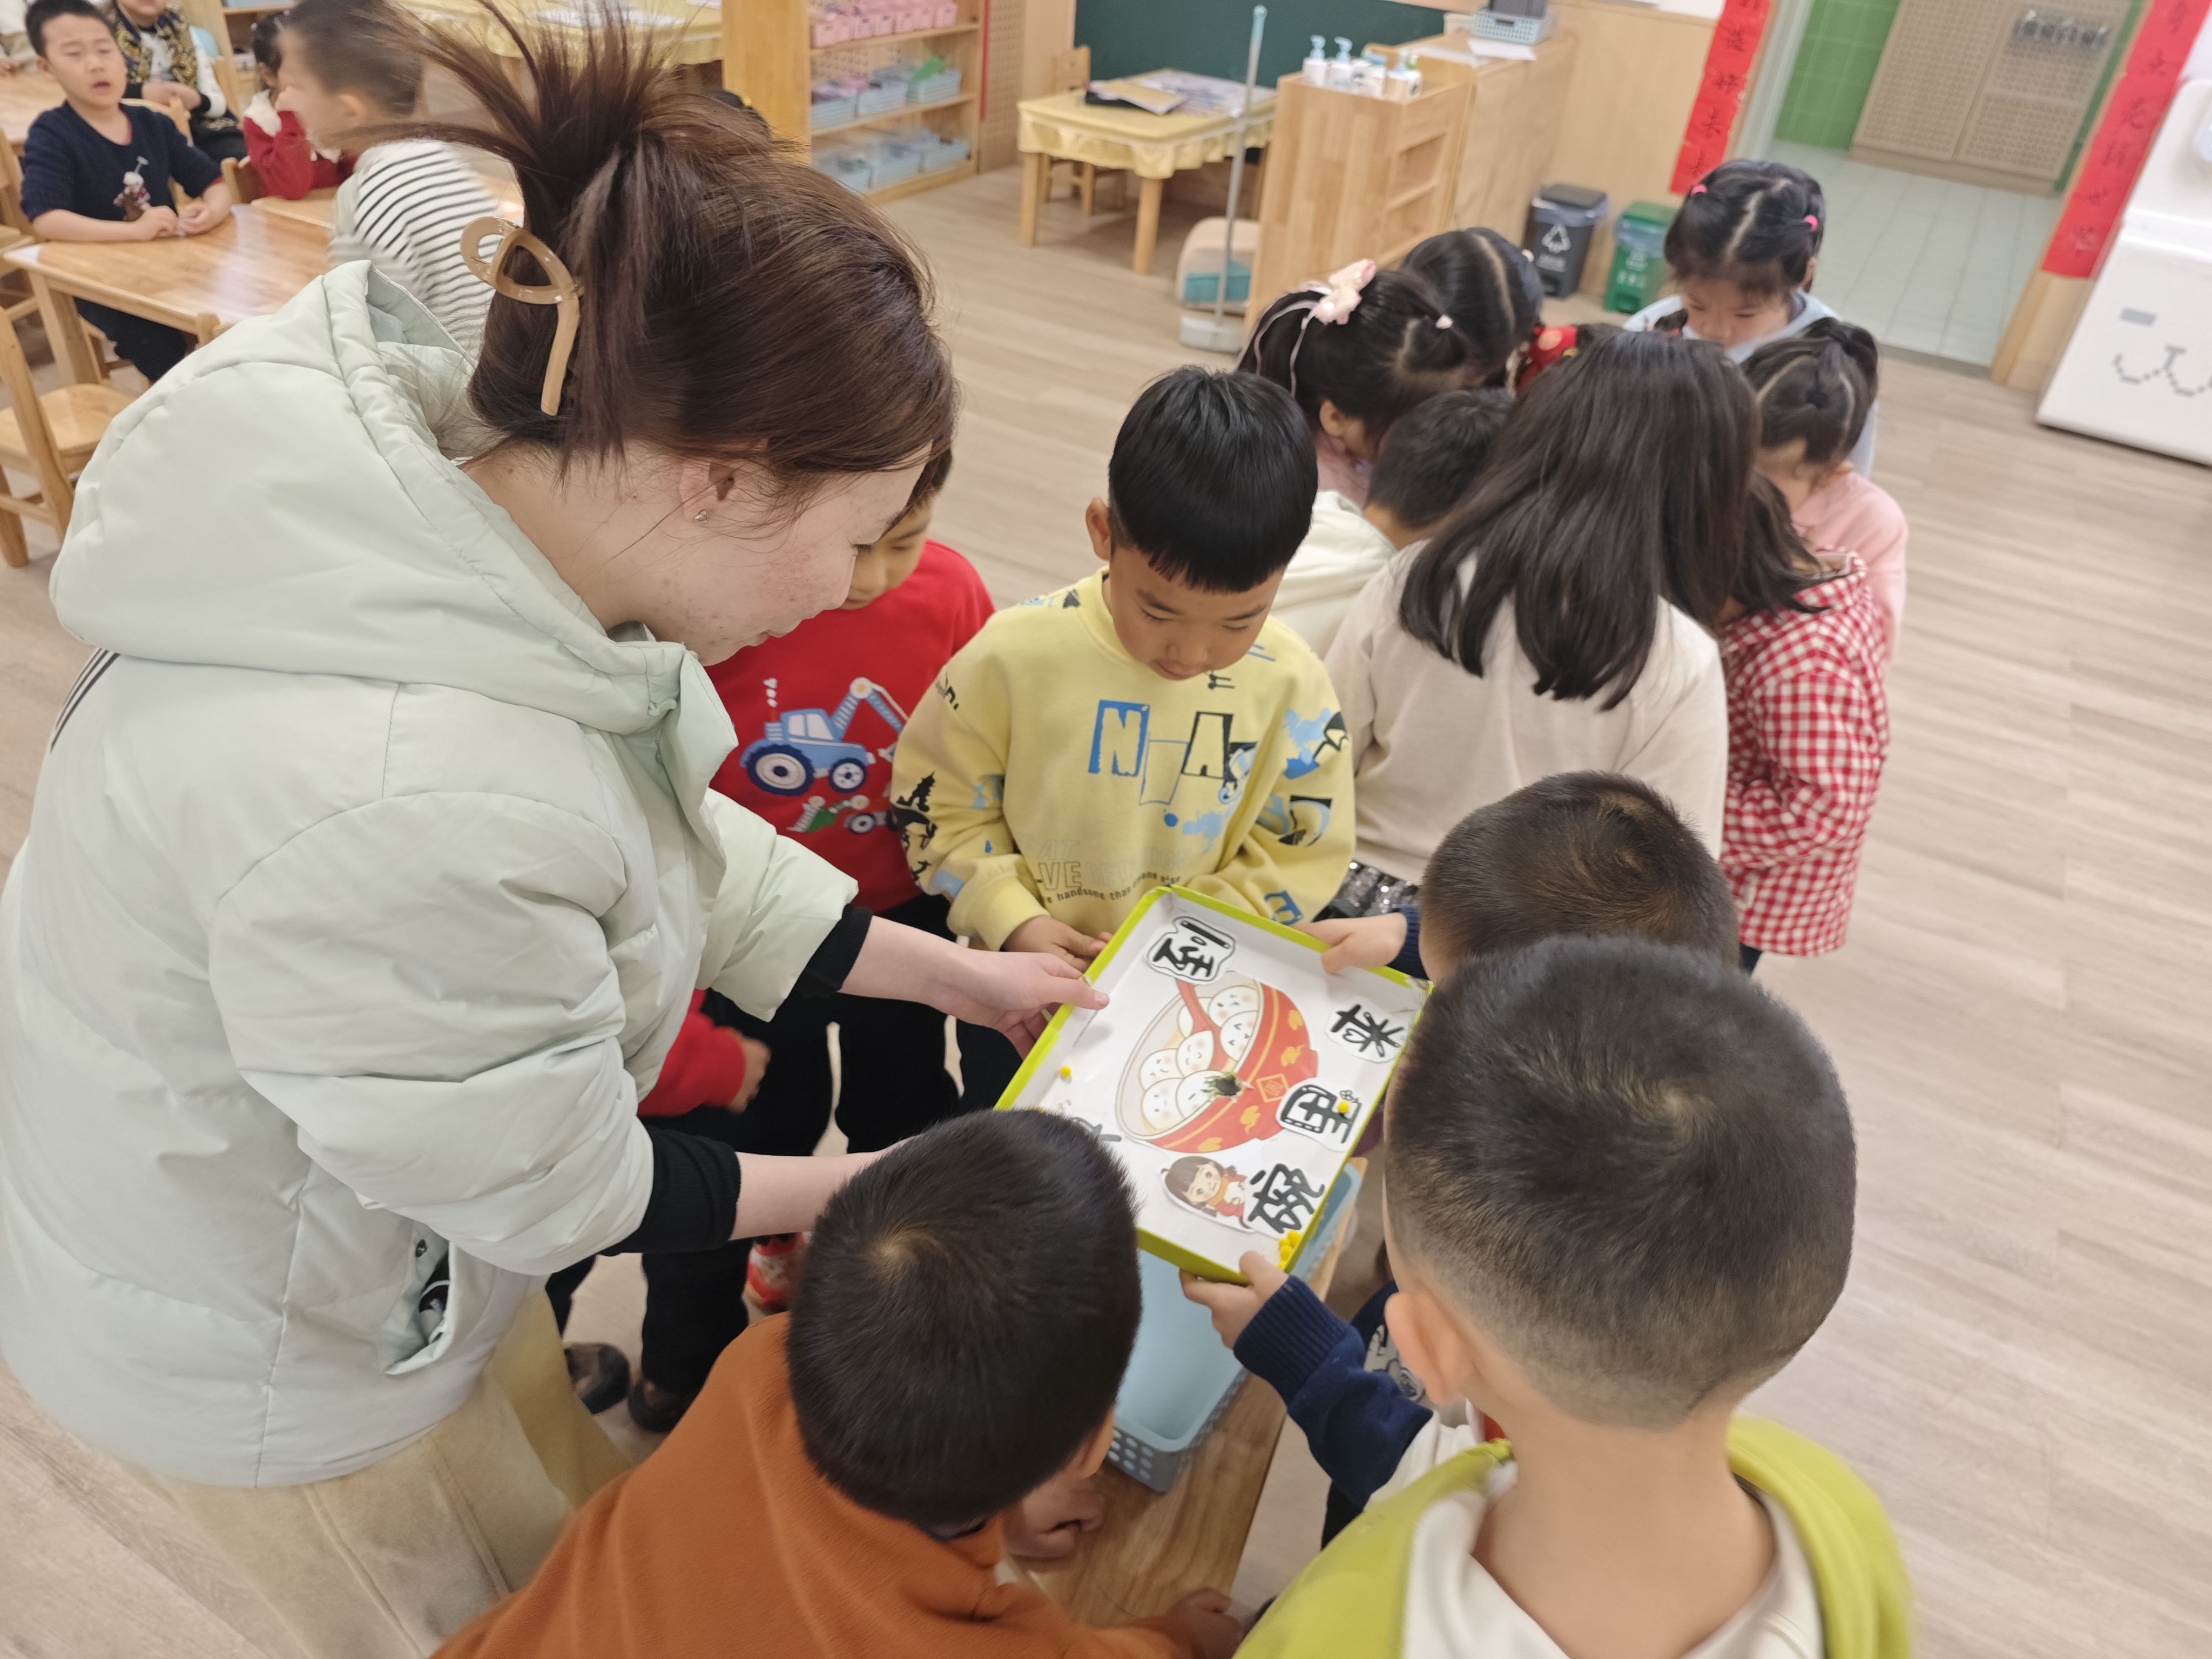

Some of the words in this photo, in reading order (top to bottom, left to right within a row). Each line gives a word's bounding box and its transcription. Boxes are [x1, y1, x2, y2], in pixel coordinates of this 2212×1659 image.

[1056, 886, 1105, 901] handsome
[1109, 886, 1132, 901] than
[1153, 919, 1232, 979] 到
